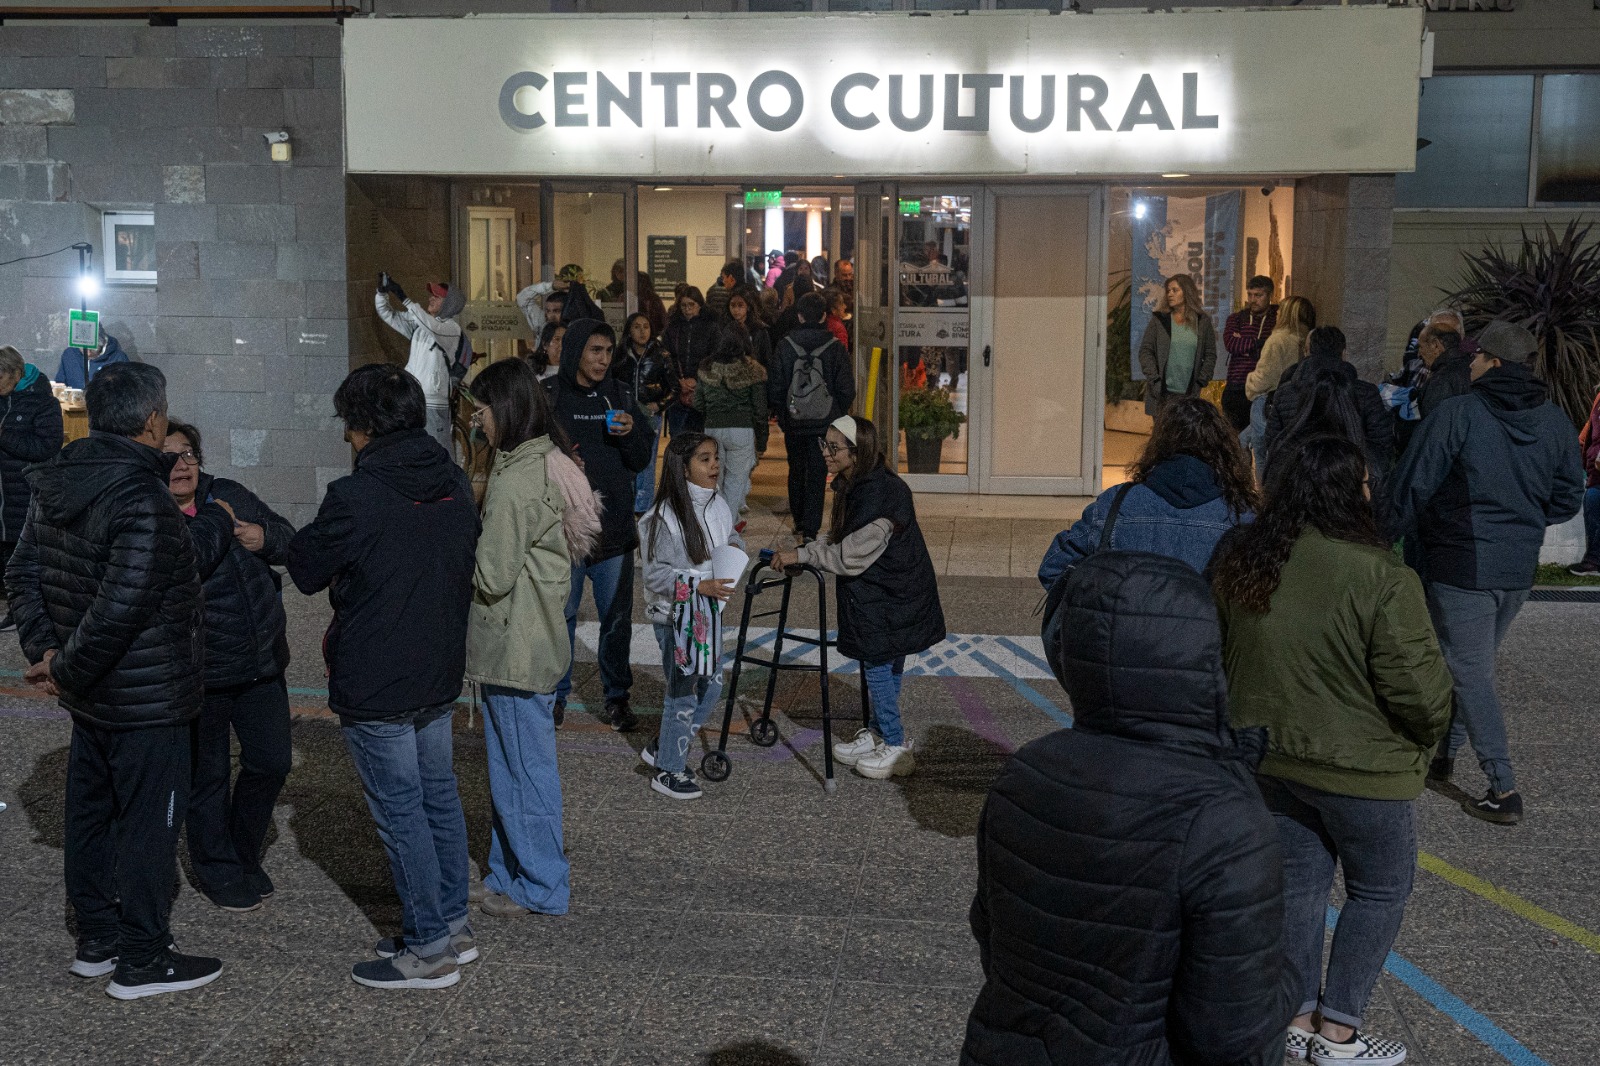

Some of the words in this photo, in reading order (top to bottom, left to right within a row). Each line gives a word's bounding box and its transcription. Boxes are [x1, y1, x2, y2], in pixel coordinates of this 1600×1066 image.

[500, 70, 804, 132] CENTRO
[830, 71, 1220, 132] CULTURAL
[900, 273, 954, 285] CULTURAL
